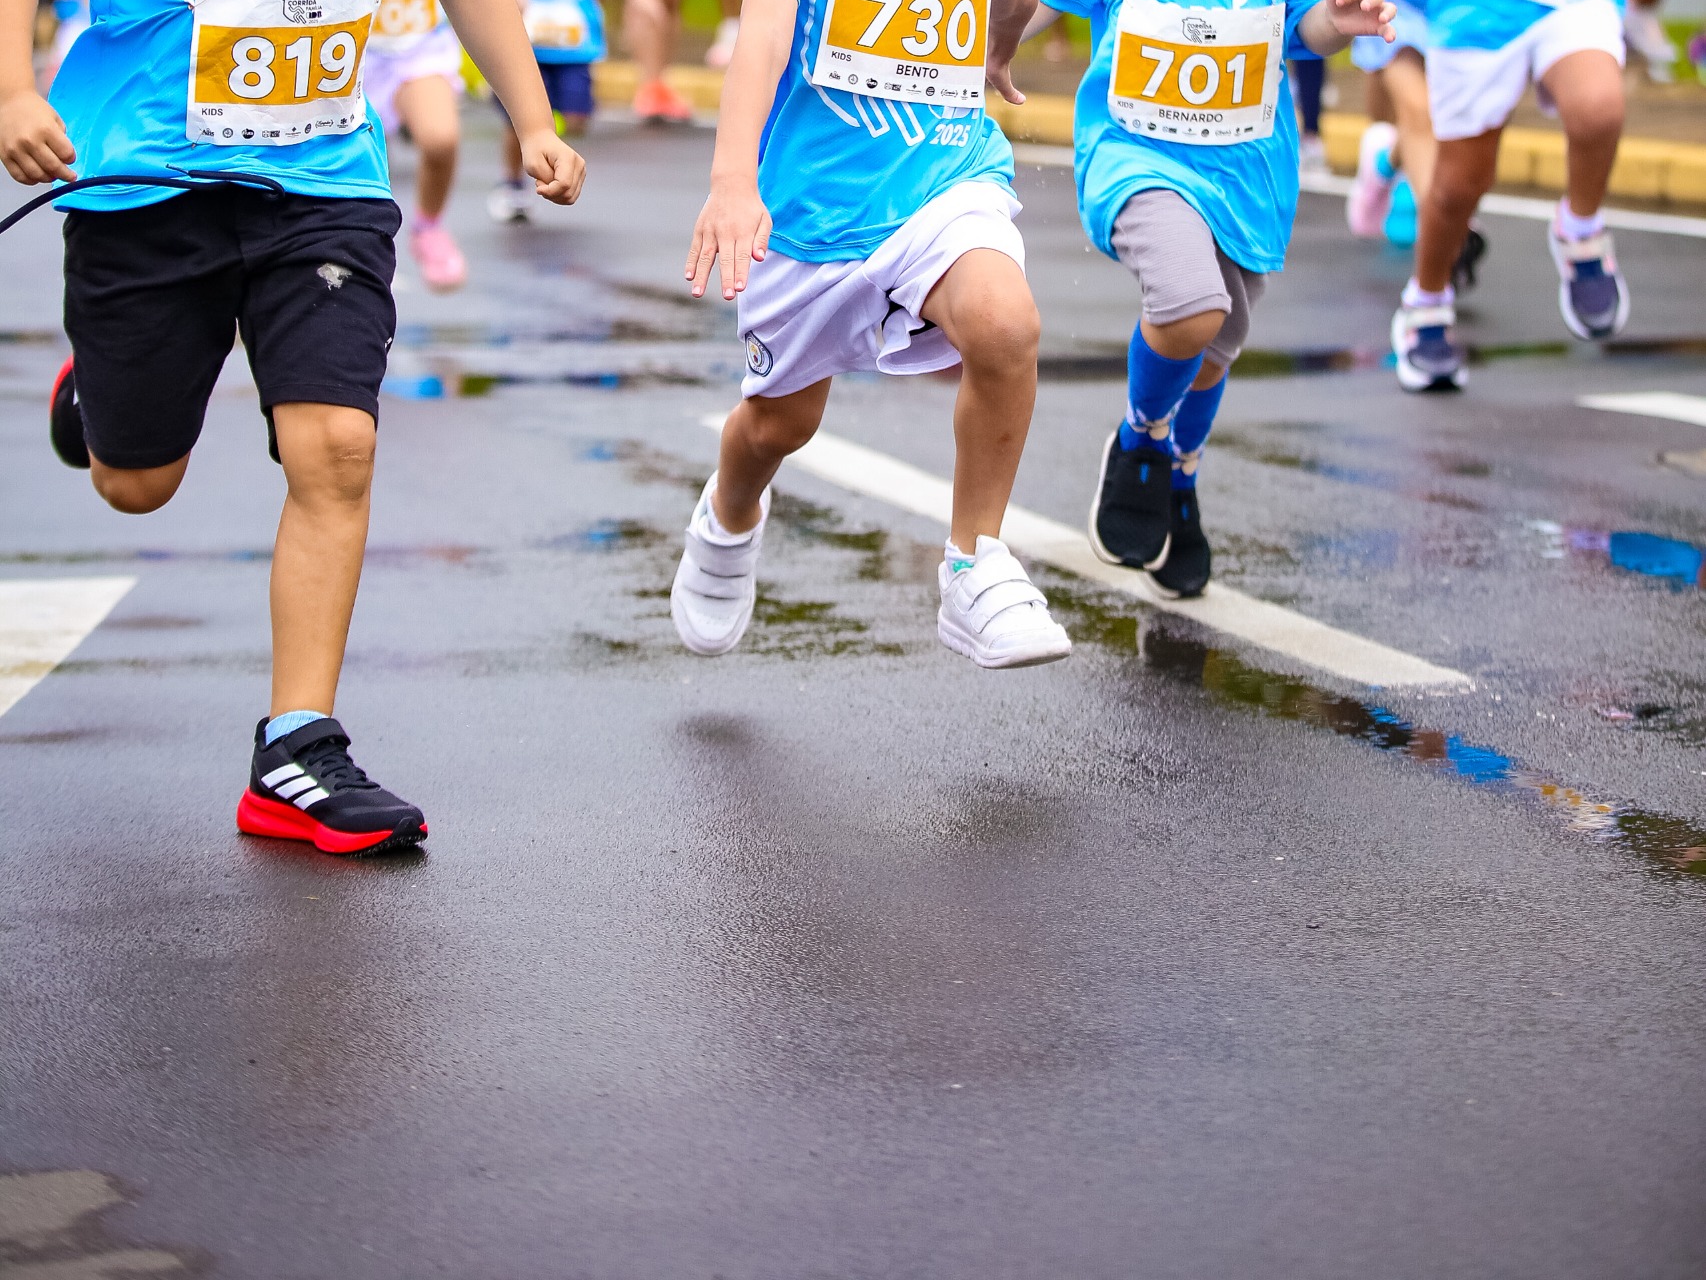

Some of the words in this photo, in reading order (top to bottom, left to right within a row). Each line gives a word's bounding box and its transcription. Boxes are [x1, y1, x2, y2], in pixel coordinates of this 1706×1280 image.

[831, 50, 853, 62] KIDS
[228, 30, 358, 99] 819
[895, 64, 939, 79] BENTO
[1140, 45, 1247, 106] 701
[201, 108, 224, 117] KIDS
[1117, 100, 1134, 110] KIDS
[1158, 108, 1224, 123] BERNARDO
[929, 123, 972, 148] 2025
